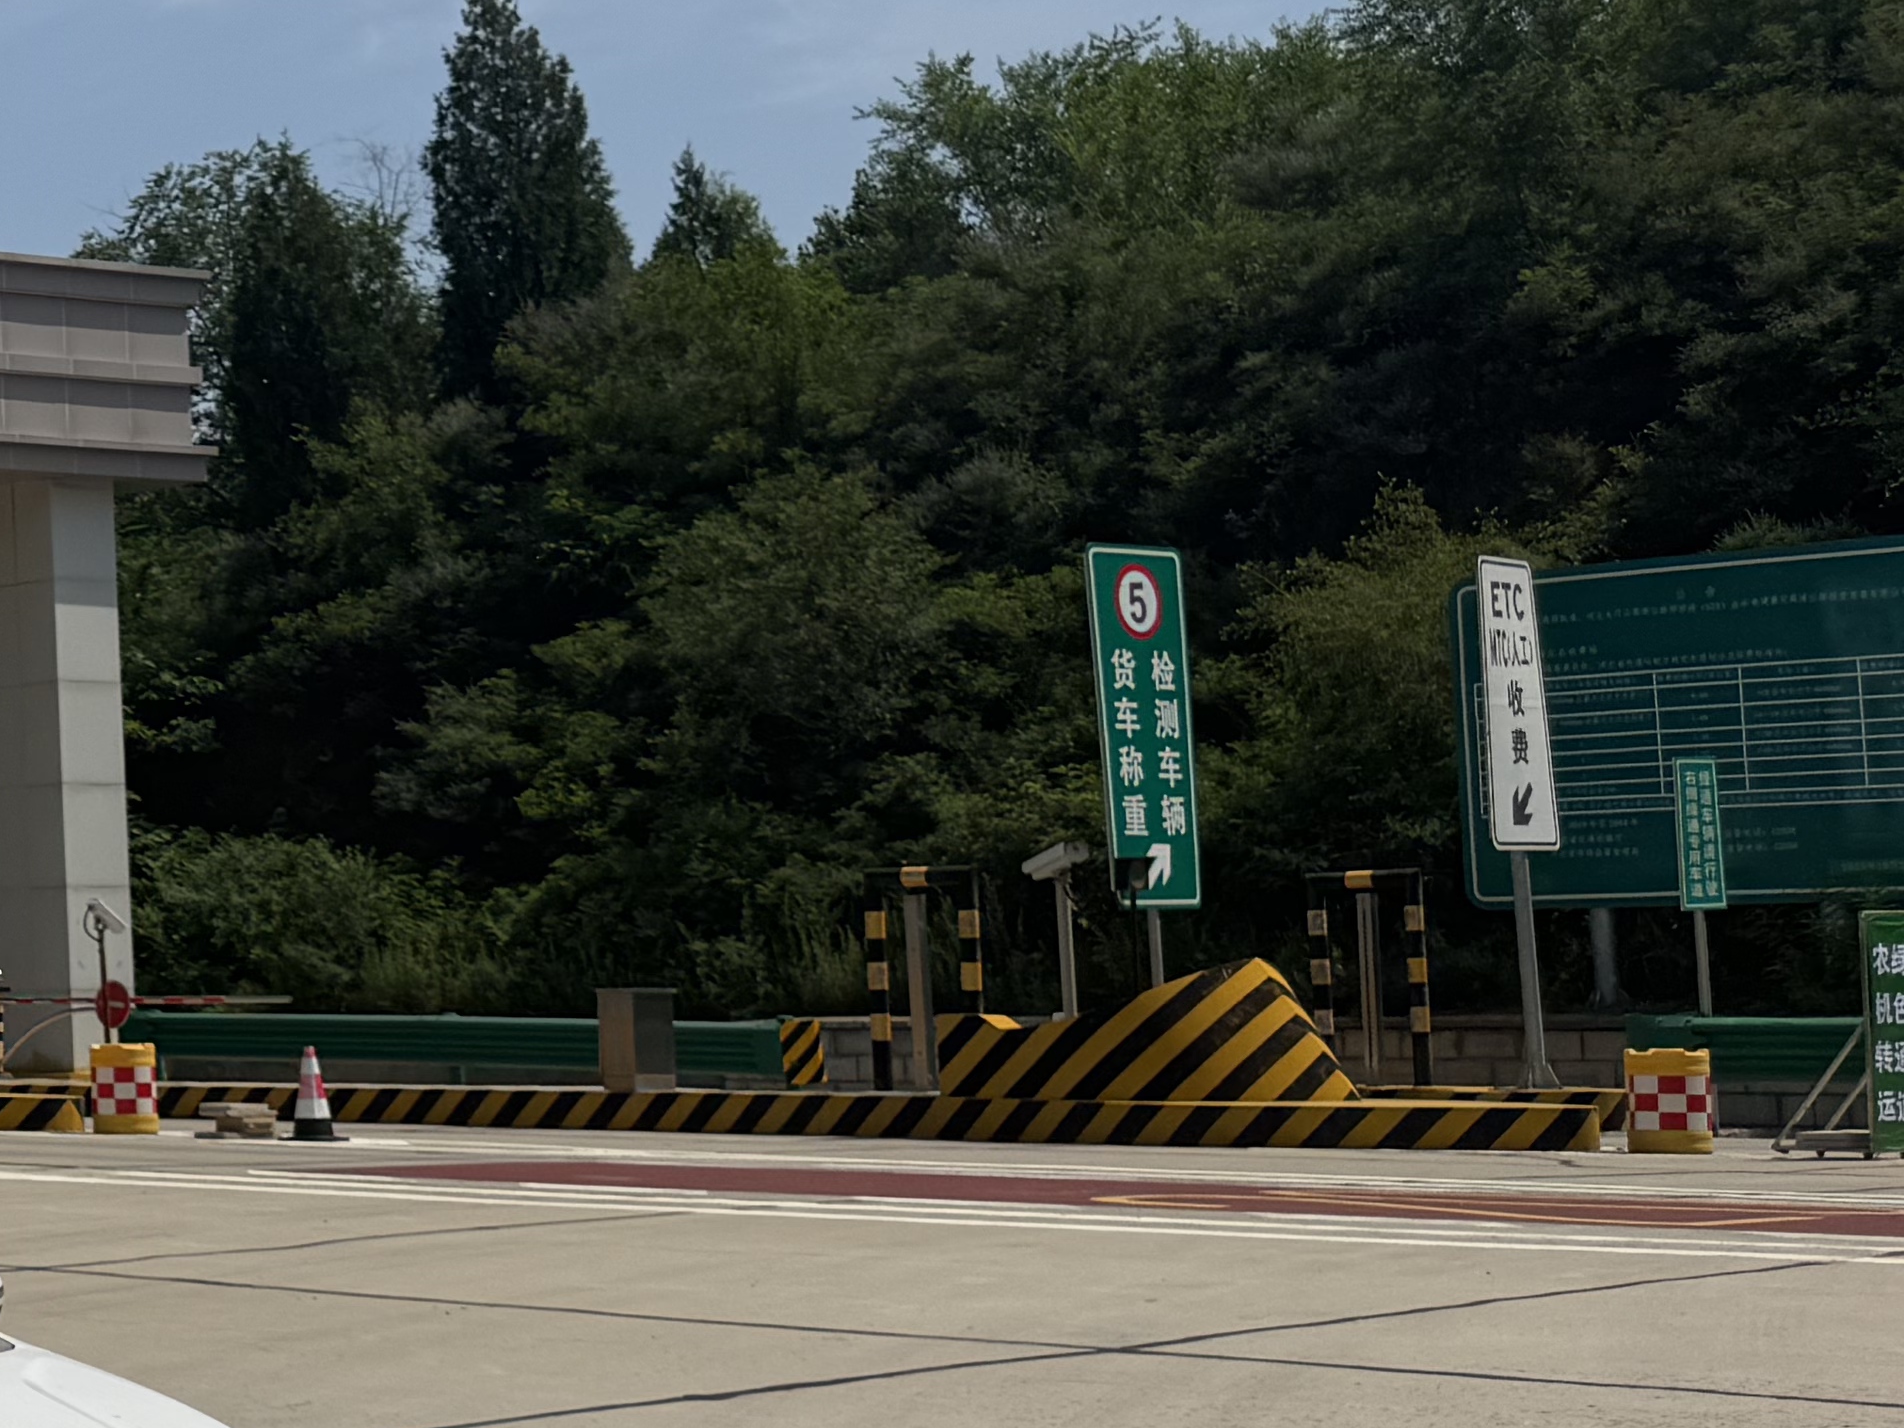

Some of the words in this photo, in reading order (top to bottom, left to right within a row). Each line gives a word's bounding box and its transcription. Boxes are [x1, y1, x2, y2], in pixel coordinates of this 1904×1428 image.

[1129, 582, 1147, 623] 5
[1490, 581, 1525, 621] ETC
[1111, 648, 1149, 837] 货车称重
[1151, 650, 1187, 837] 检测车辆
[1507, 680, 1530, 765] 收费
[1872, 942, 1897, 1123] 农机转运
